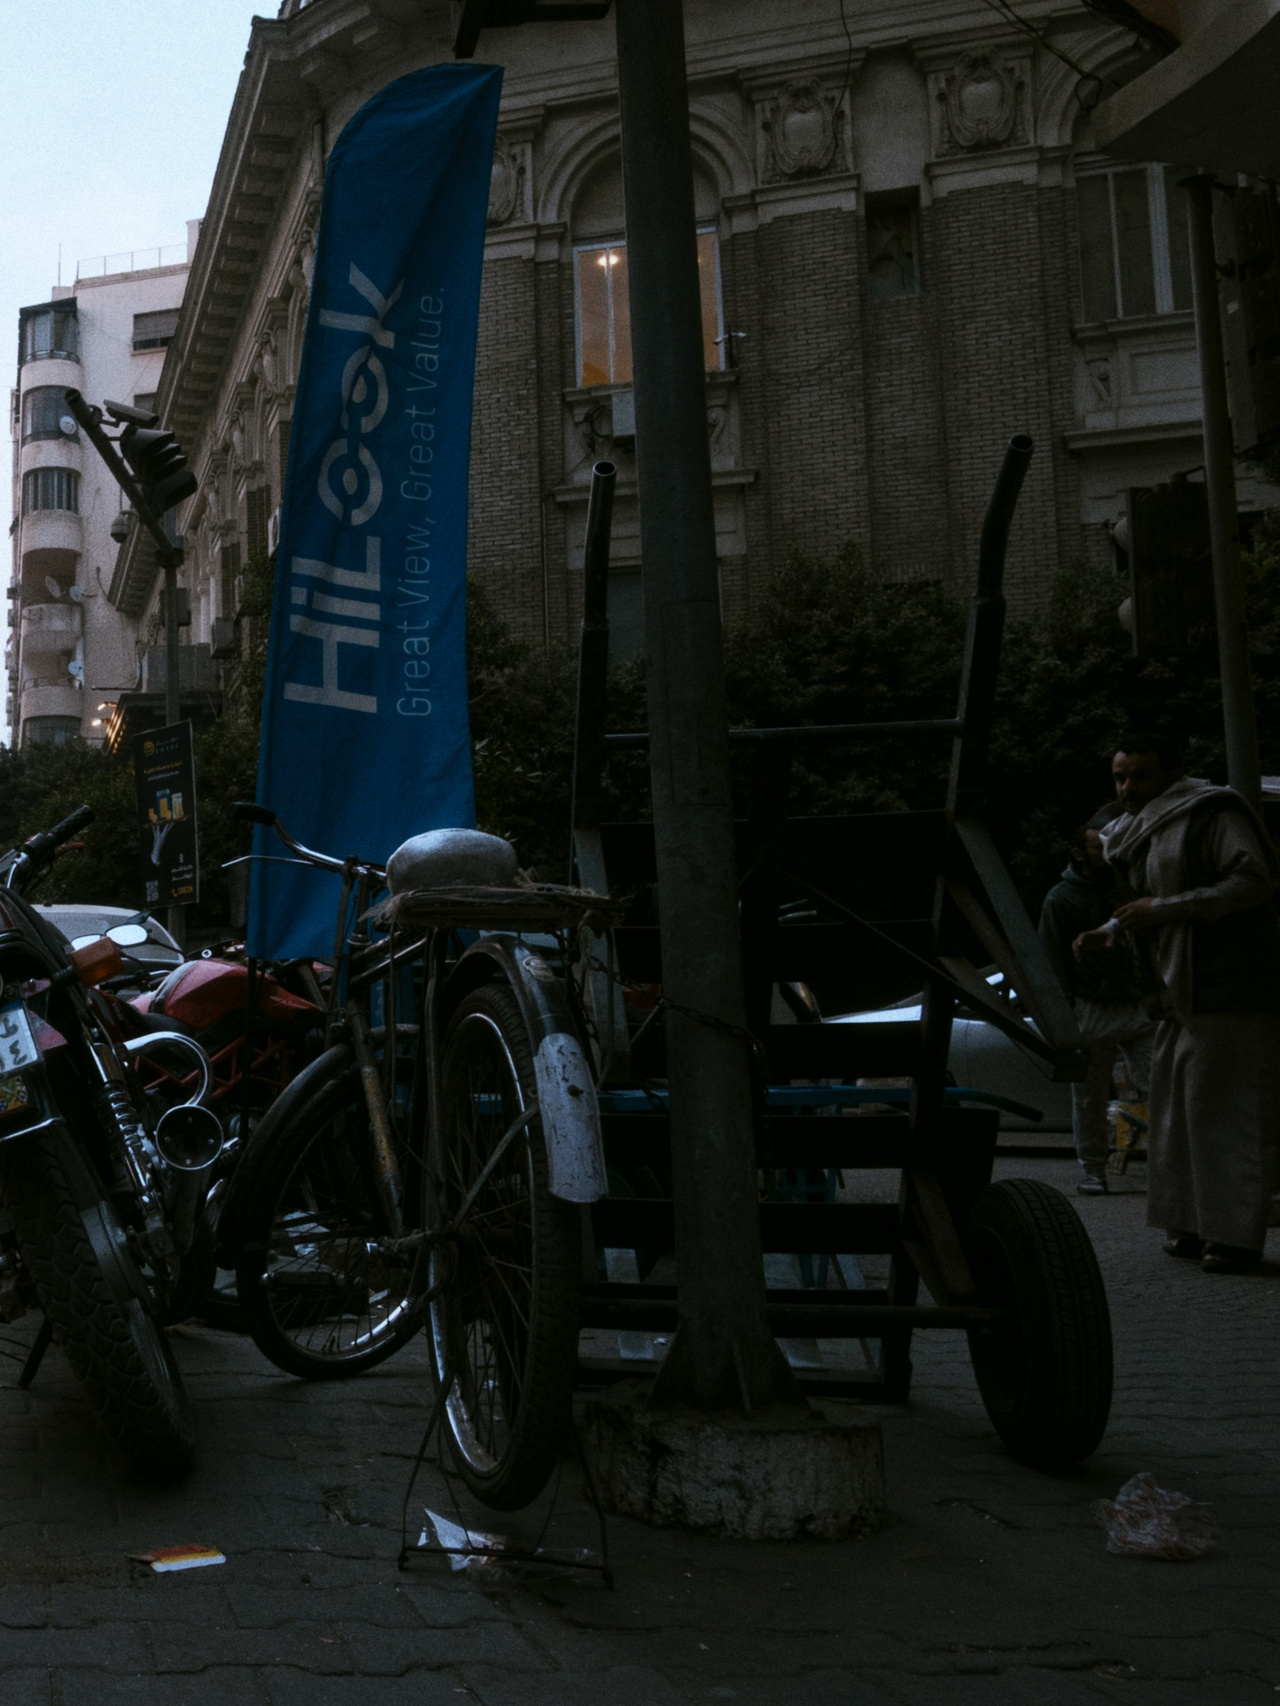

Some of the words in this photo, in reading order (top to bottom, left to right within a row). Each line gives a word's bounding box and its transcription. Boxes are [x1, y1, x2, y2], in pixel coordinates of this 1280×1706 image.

[406, 287, 445, 392] Value.
[400, 405, 436, 501] Great
[397, 517, 437, 607] View,
[396, 620, 433, 717] Great
